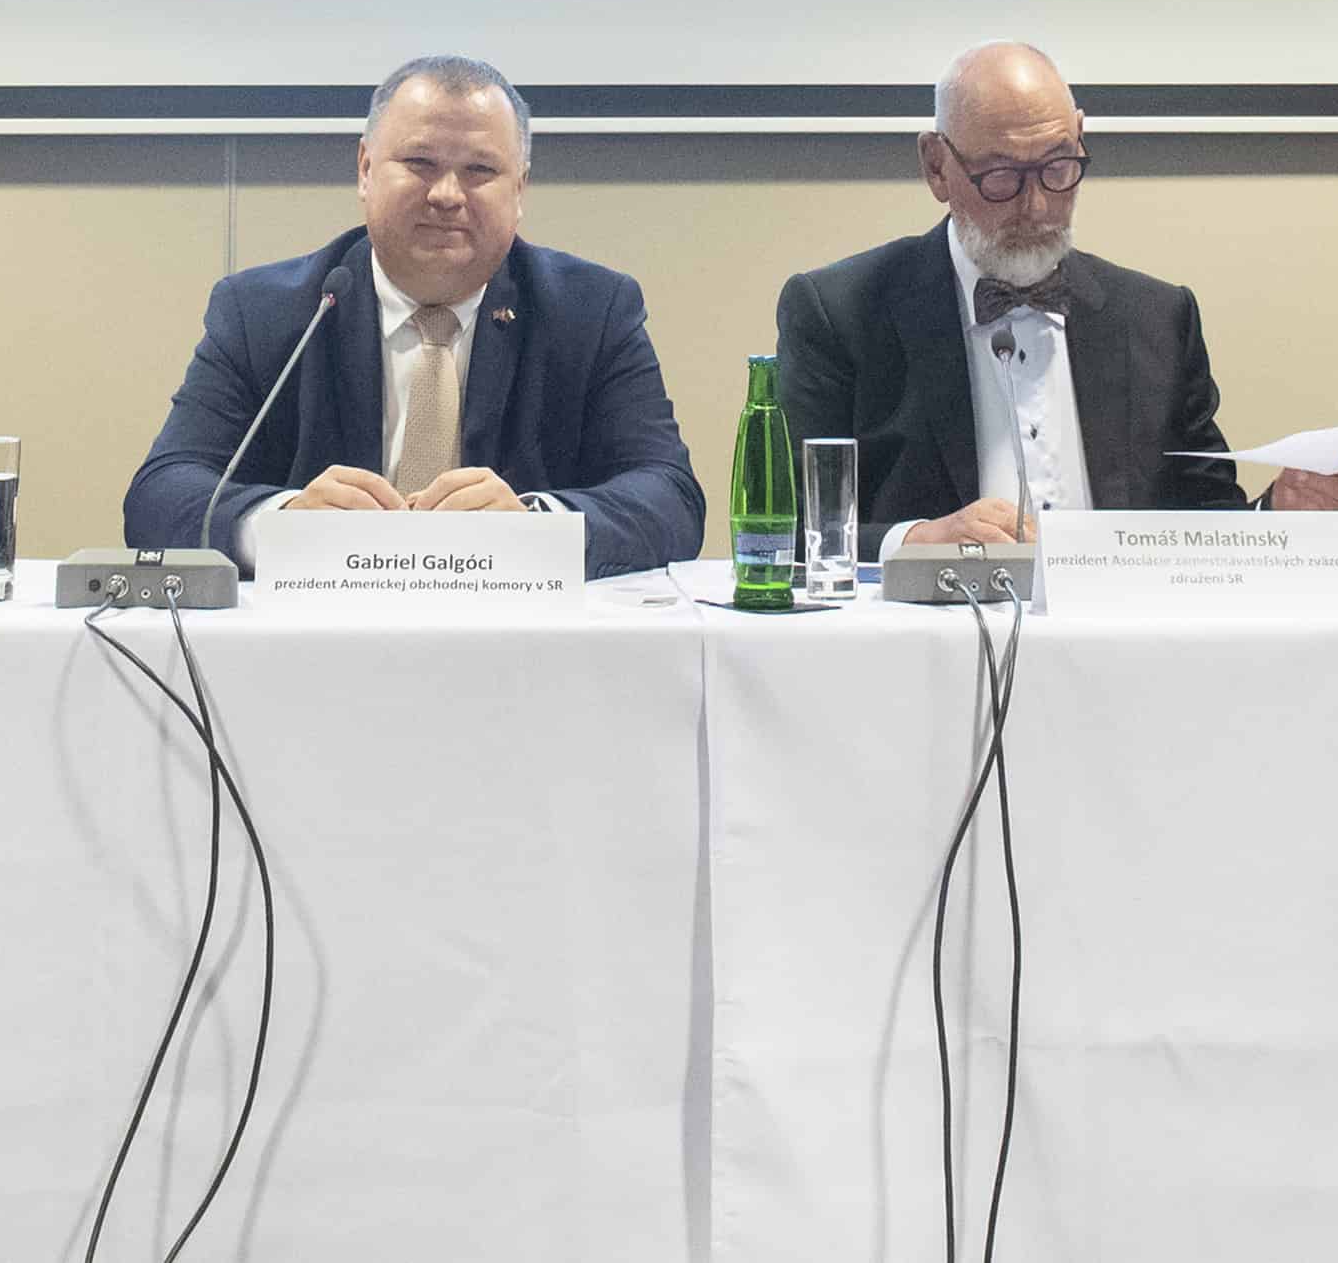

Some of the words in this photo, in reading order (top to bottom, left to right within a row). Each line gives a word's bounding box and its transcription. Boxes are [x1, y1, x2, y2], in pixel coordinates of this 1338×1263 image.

[1114, 530, 1179, 546] Tomáš
[1184, 530, 1289, 550] Malatinský
[346, 553, 416, 570] Gabriel
[422, 553, 493, 574] Galgóci
[1047, 555, 1107, 567] prezident
[274, 578, 337, 591] prezident
[340, 578, 406, 591] Americkej
[409, 578, 479, 592] obchodnej
[482, 579, 533, 592] komory
[535, 582, 544, 590] v
[547, 579, 563, 590] SR
